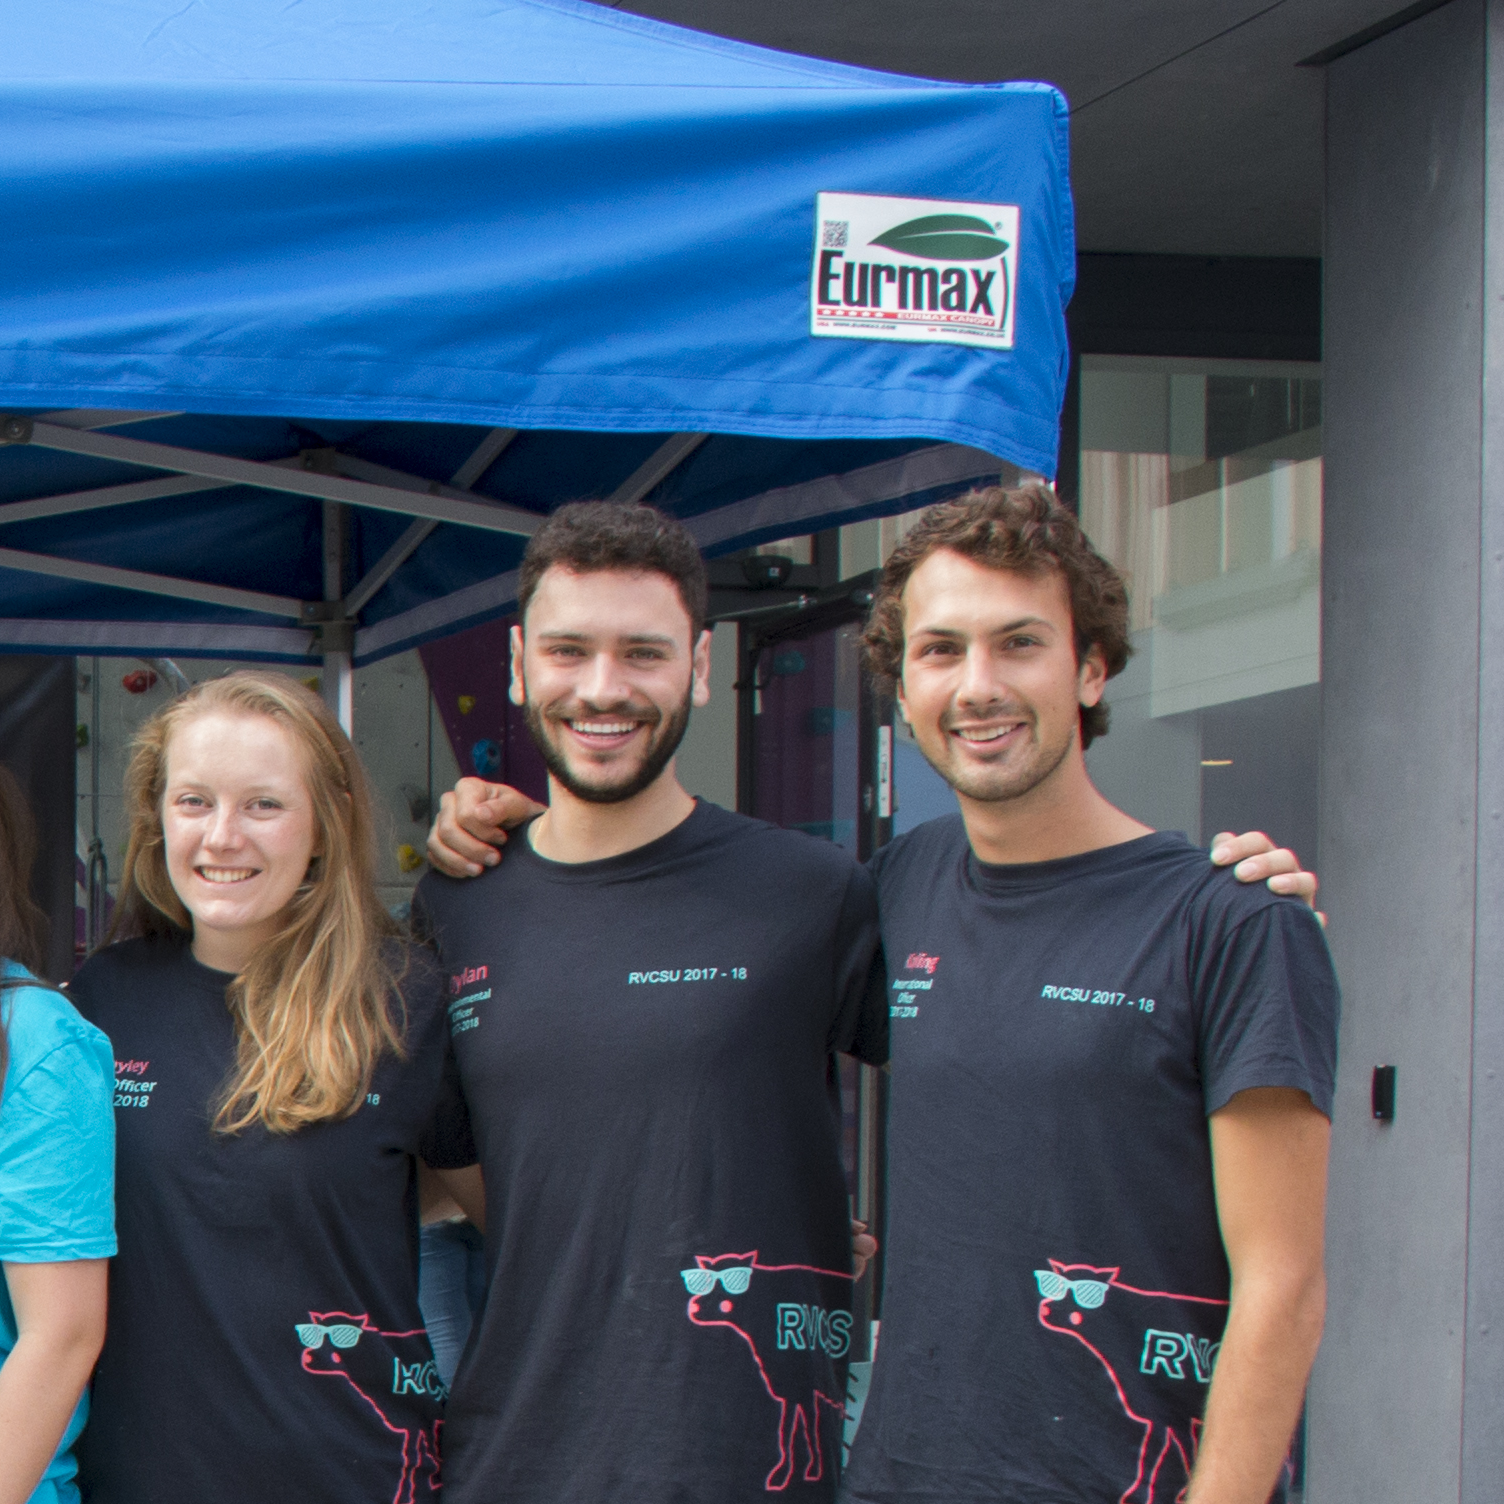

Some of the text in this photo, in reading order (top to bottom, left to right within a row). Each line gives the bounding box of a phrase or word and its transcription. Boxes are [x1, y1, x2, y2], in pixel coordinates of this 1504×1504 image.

[818, 249, 996, 316] Eurmax
[627, 970, 681, 985] RVCSU
[682, 967, 719, 982] 2017
[730, 967, 748, 981] 18
[1041, 984, 1091, 1003] RVCSU
[1091, 990, 1127, 1007] 2017
[1137, 997, 1156, 1014] 18
